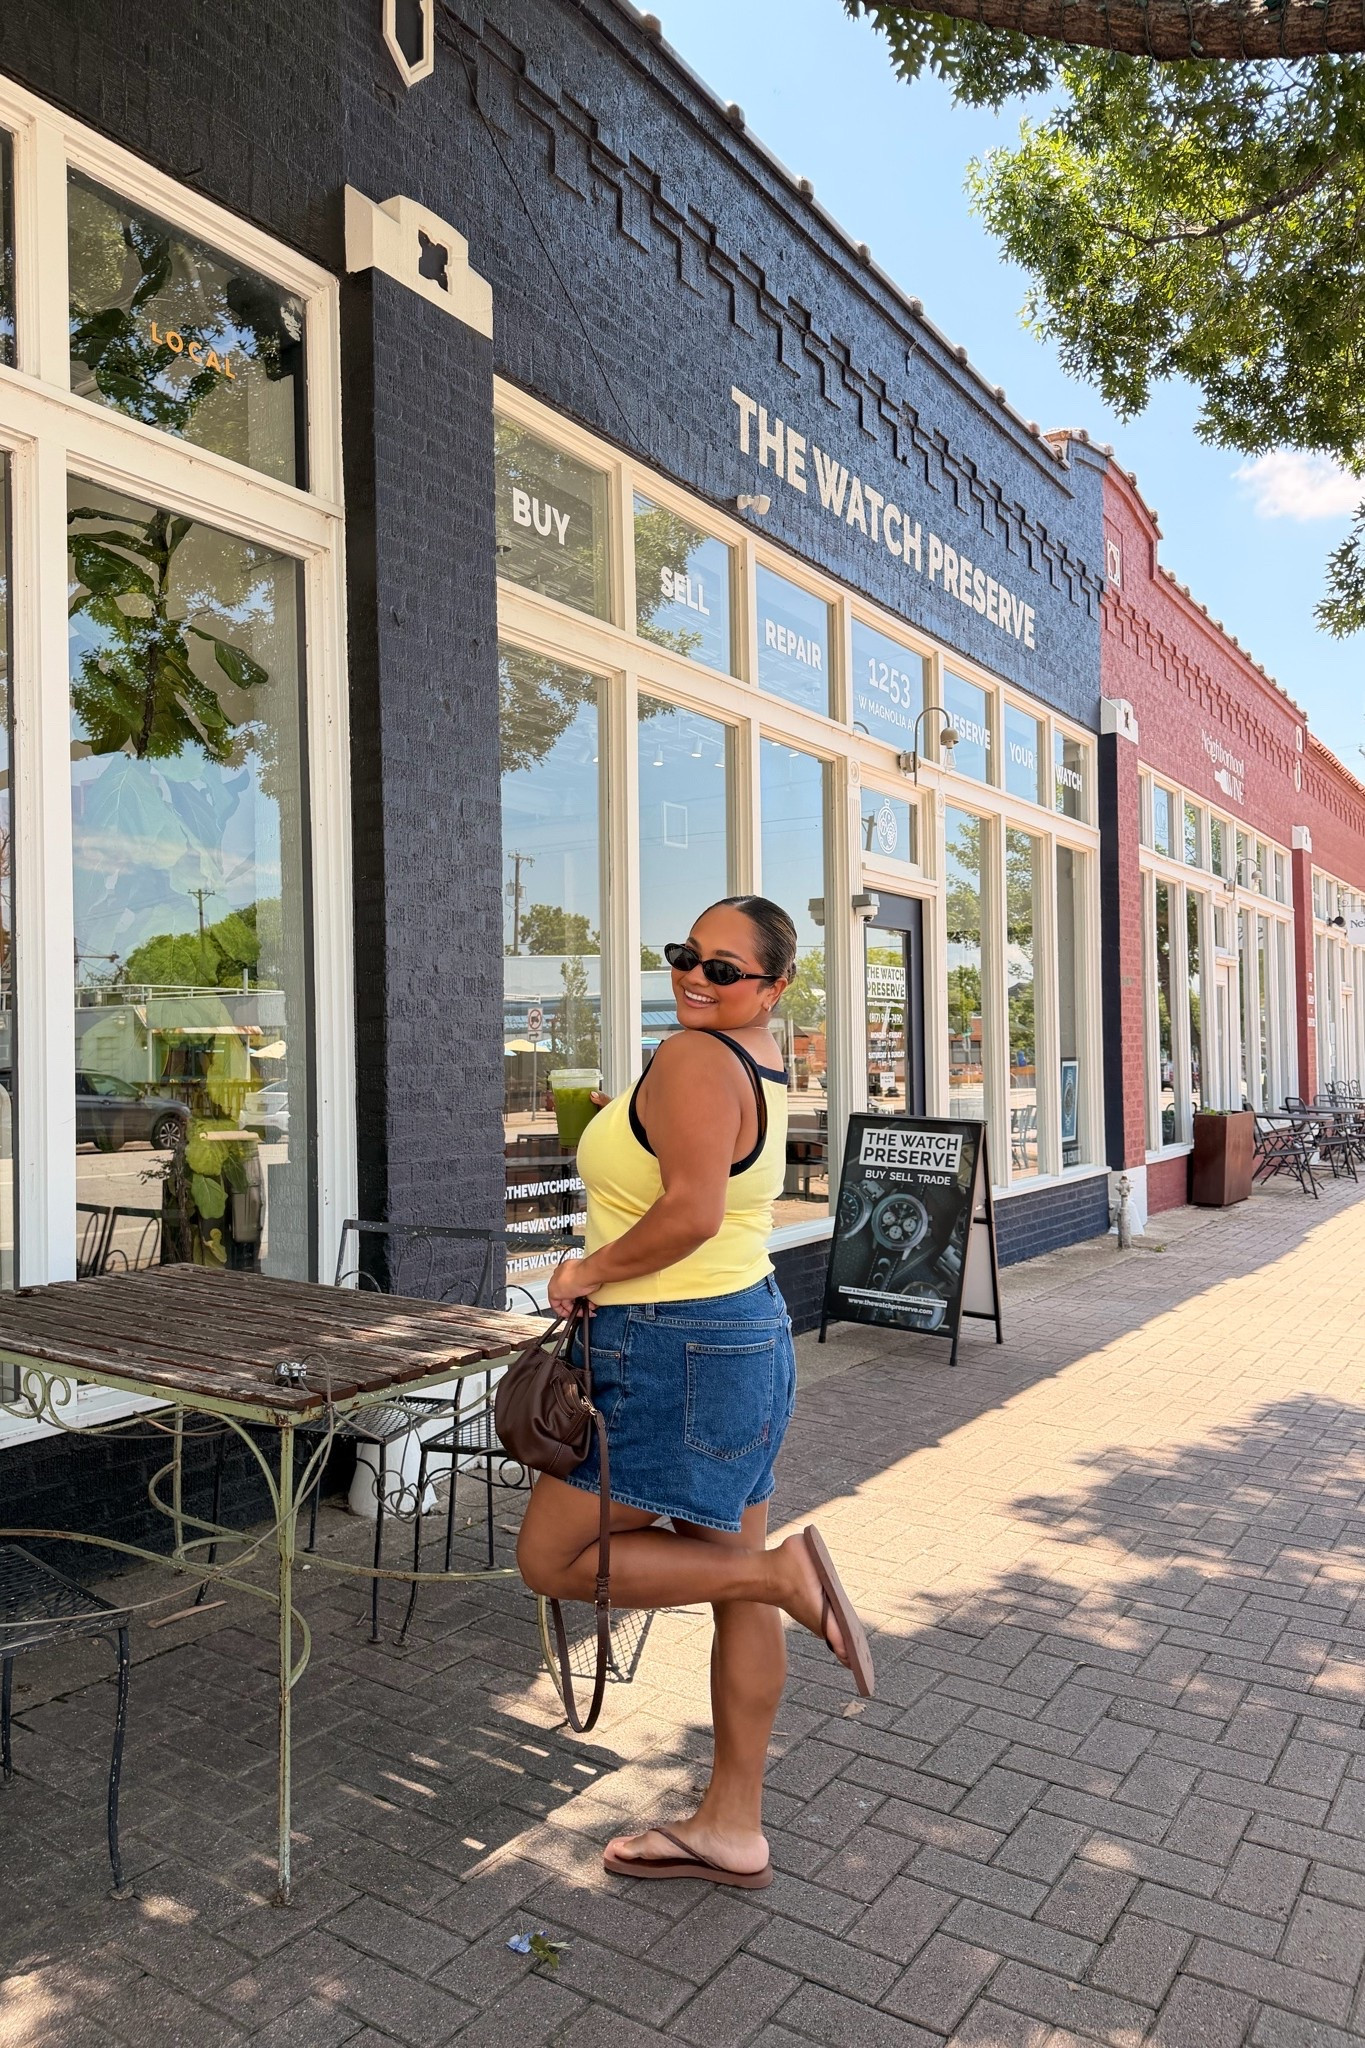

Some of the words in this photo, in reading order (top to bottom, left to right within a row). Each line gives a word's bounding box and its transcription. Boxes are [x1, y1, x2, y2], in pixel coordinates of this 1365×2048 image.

[151, 321, 236, 380] LOCAL
[731, 384, 807, 494] THE
[812, 444, 922, 573] WATCH
[928, 532, 1036, 650] PRESERVE
[512, 486, 571, 546] BUY
[660, 565, 710, 616] SELL
[765, 618, 823, 671] REPAIR
[868, 657, 911, 709] 1253
[858, 694, 867, 710] W
[868, 699, 907, 729] MAGNOLIA
[1009, 741, 1034, 770] YOUR
[1054, 763, 1083, 793] WATCH
[1201, 728, 1244, 779] Neighborhood
[867, 965, 880, 979] THE
[880, 967, 905, 982] WATCH
[866, 1132, 898, 1147] THE
[900, 1134, 959, 1151] WATCH
[863, 1147, 957, 1168] PRESERVE
[865, 1169, 886, 1180] BUY
[889, 1171, 913, 1183] SELL
[917, 1173, 951, 1186] TRADE
[505, 1211, 587, 1233] THEWATCHPRES
[506, 1246, 585, 1274] THEWATCHPRE
[848, 1298, 933, 1315] www.thewatchpreserve.com
